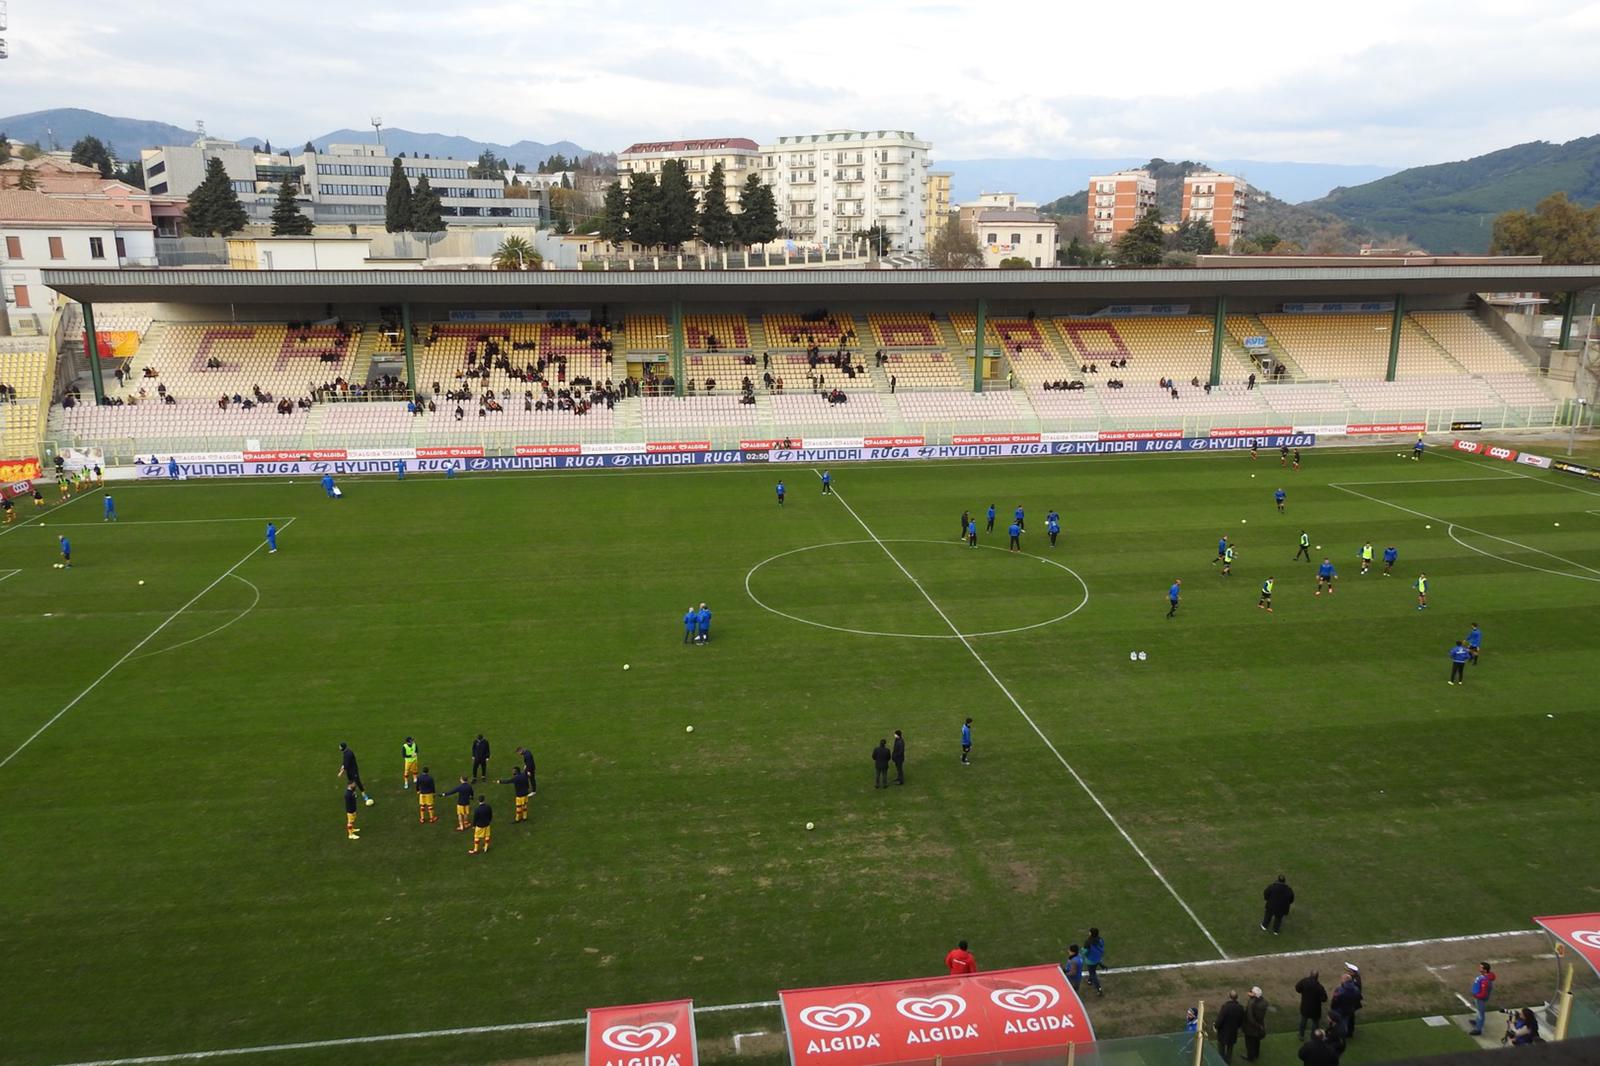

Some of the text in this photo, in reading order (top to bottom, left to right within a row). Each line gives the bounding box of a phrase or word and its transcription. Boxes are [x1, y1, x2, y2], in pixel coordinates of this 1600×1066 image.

[796, 444, 1048, 460] HYUNDAI RUGA HYUNDAI RUGA
[1076, 441, 1138, 453] HYUNDAI
[1145, 440, 1182, 450] RUGA
[1276, 436, 1312, 446] RUGA
[492, 452, 742, 469] HYUNDAI RUGA HYUNDAI RUGA
[746, 453, 769, 461] 02:50
[256, 463, 300, 474] RUGA
[806, 1014, 1074, 1054] ALGIDA ALGIDA ALGIDA
